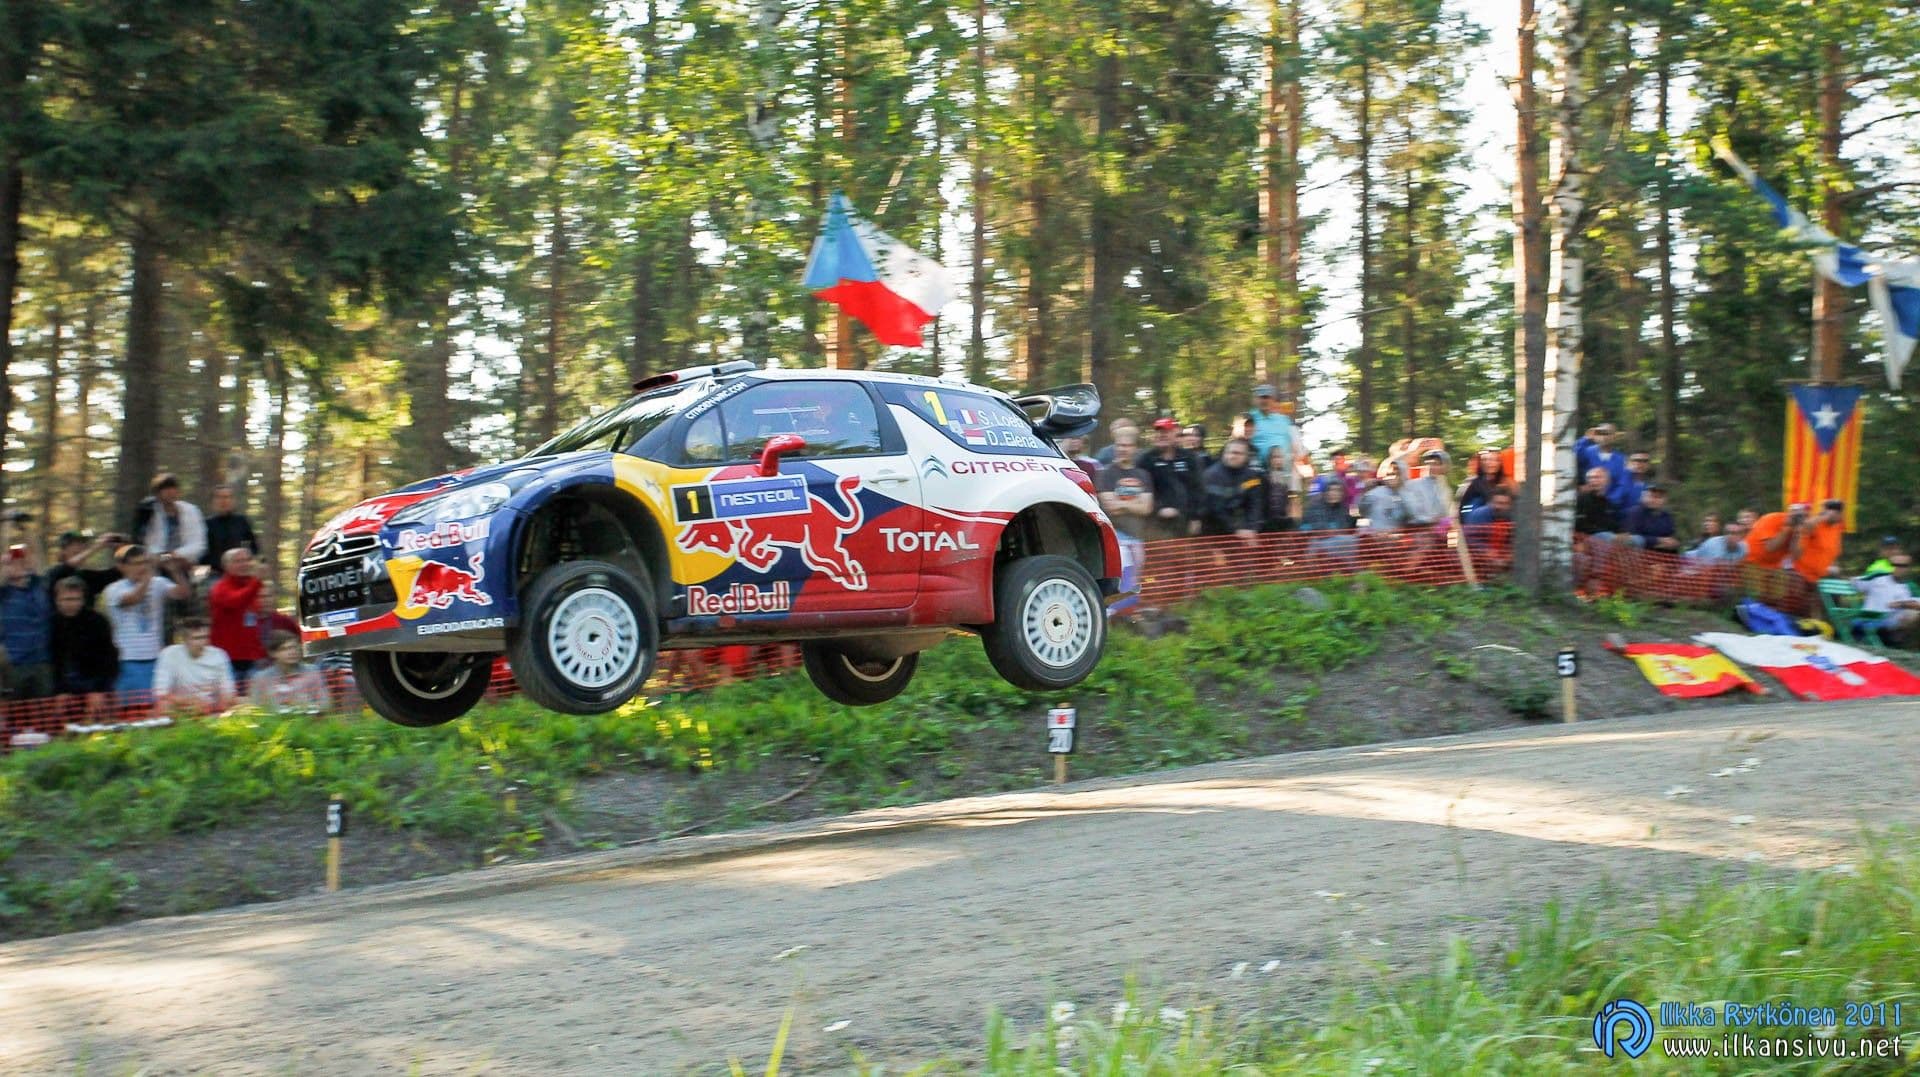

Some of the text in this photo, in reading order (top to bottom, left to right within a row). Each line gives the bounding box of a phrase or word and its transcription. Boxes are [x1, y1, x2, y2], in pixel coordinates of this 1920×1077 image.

[923, 391, 949, 426] 1
[986, 430, 1038, 449] D. Elena
[686, 490, 700, 514] 1
[879, 528, 980, 553] TOTAL
[1558, 654, 1576, 676] 5
[326, 803, 342, 834] 5
